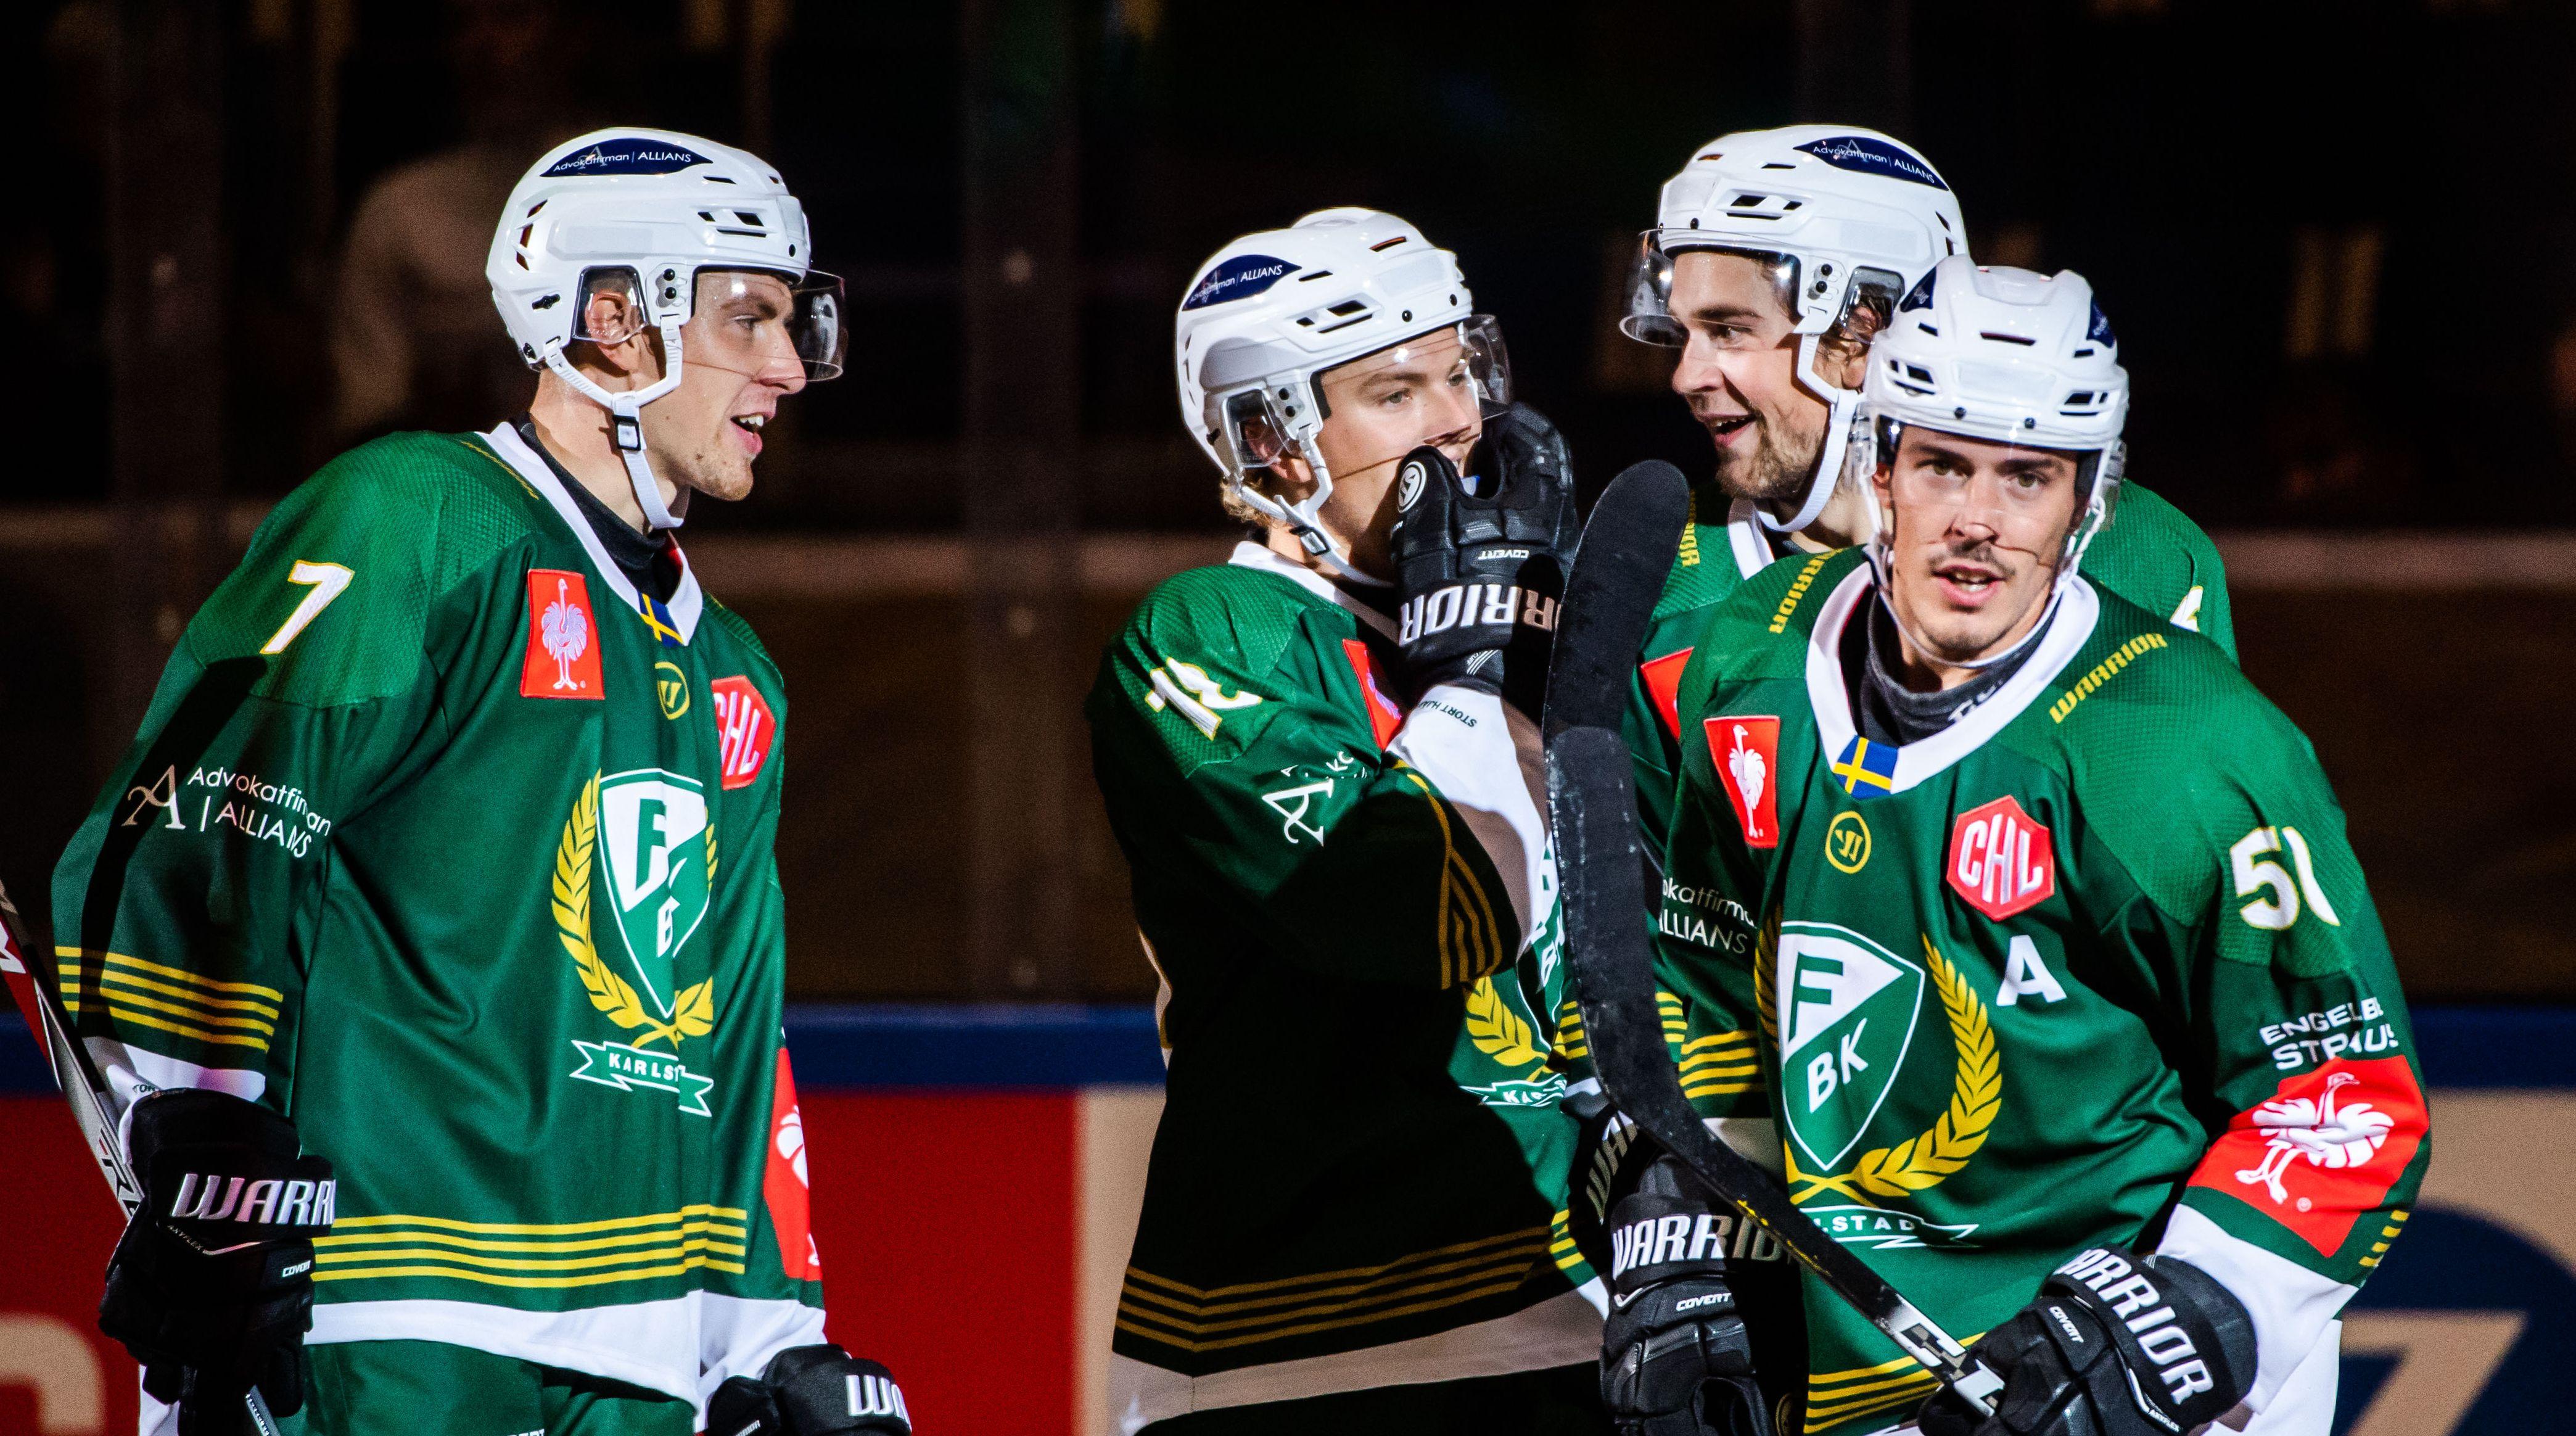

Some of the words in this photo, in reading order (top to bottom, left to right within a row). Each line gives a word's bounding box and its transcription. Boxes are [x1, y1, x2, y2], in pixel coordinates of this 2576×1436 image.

[638, 151, 691, 163] ALLIANS
[1894, 158, 1935, 184] ALLIANS
[1240, 265, 1283, 283] ALLIANS
[1478, 549, 1529, 561] COVERT
[259, 559, 356, 655] 7
[1398, 584, 1562, 648] RRIOR
[1439, 704, 1477, 728] STORT
[214, 801, 312, 858] ALLIANS
[1957, 812, 2043, 905] CHL
[1996, 934, 2067, 1007] A
[2258, 996, 2384, 1046] ENGELB
[1807, 1018, 1869, 1114] BK
[1676, 1292, 1732, 1312] COVERT
[2048, 1306, 2084, 1343] COVERT
